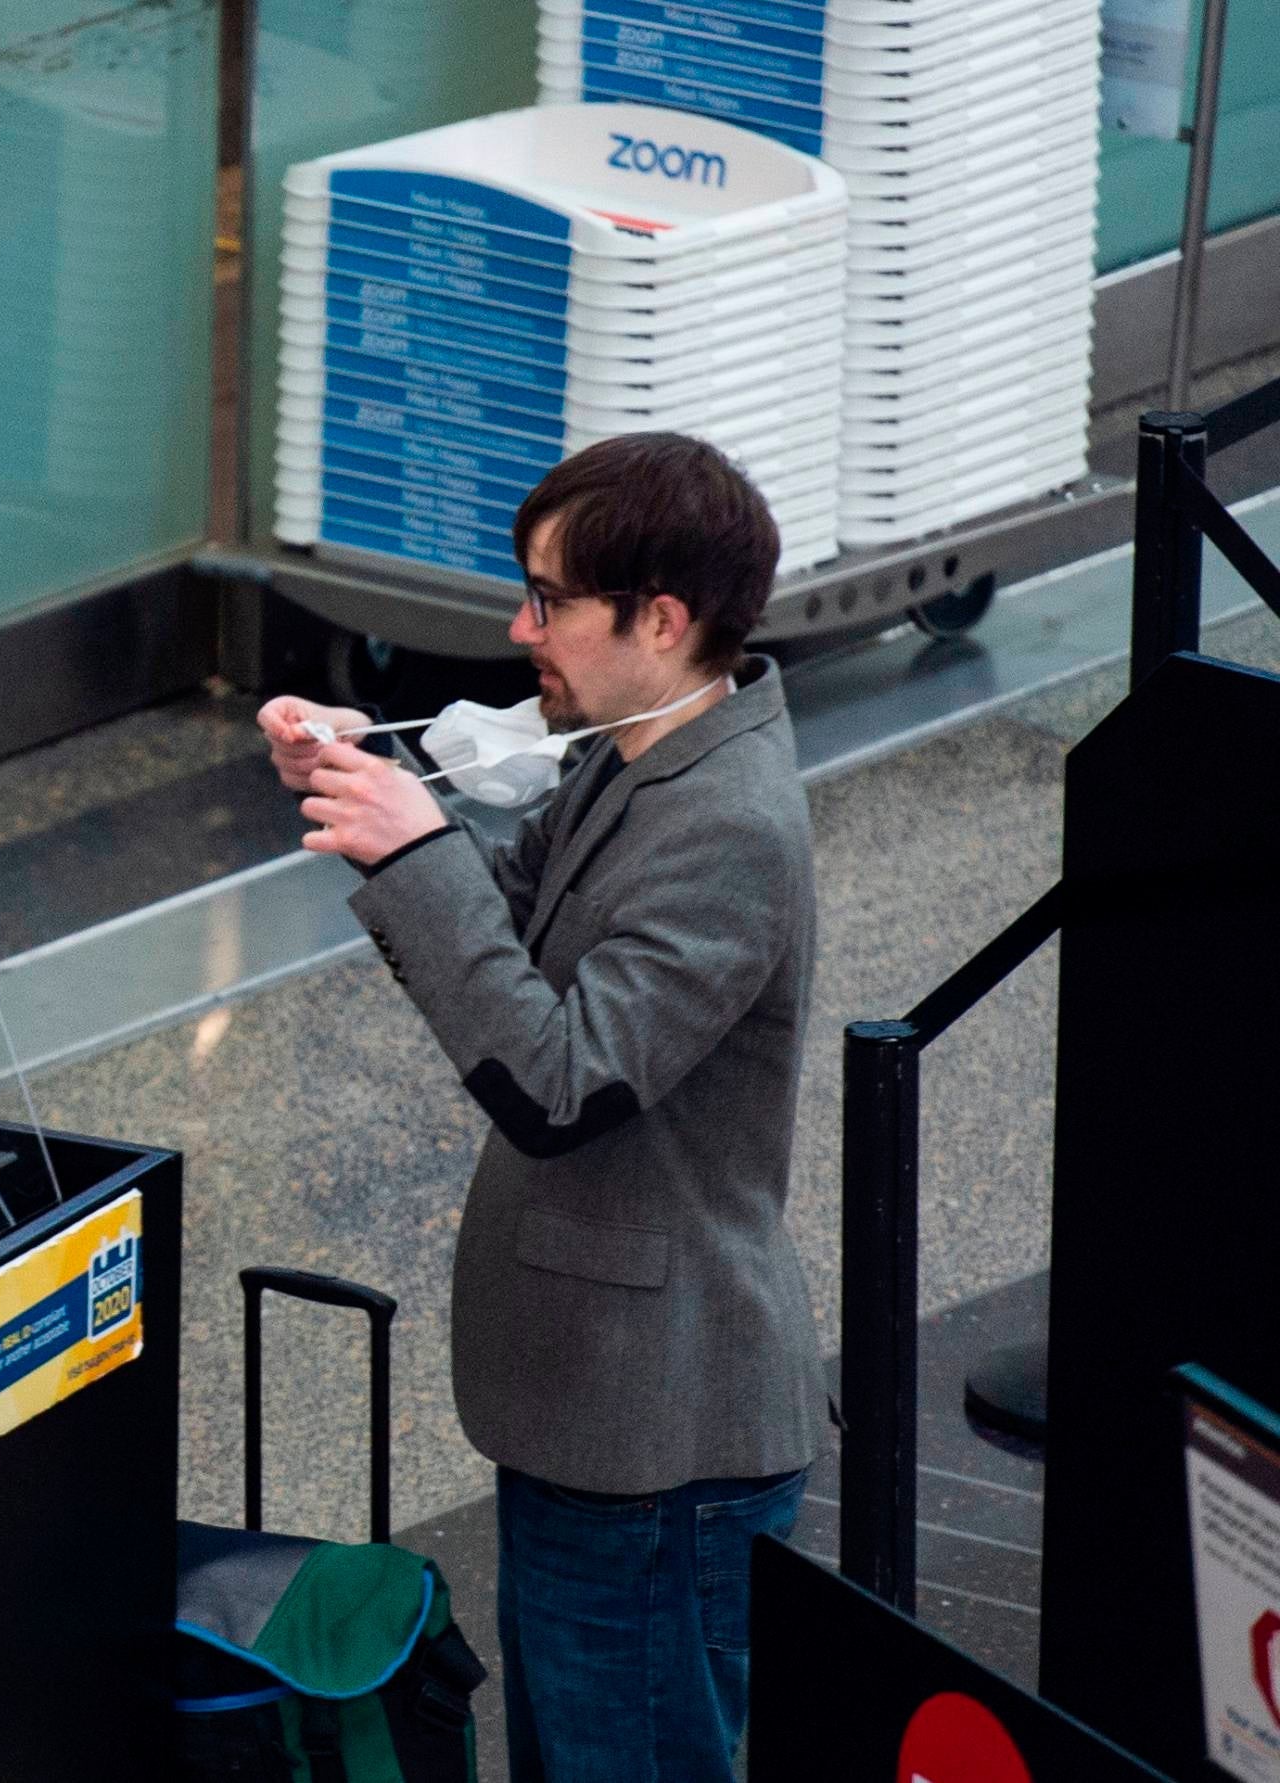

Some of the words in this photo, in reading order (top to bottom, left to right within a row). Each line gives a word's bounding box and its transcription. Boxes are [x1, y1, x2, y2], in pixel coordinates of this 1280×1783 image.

[607, 132, 726, 188] zoom
[93, 1260, 132, 1294] OCTOBER
[95, 1287, 129, 1325] 2020
